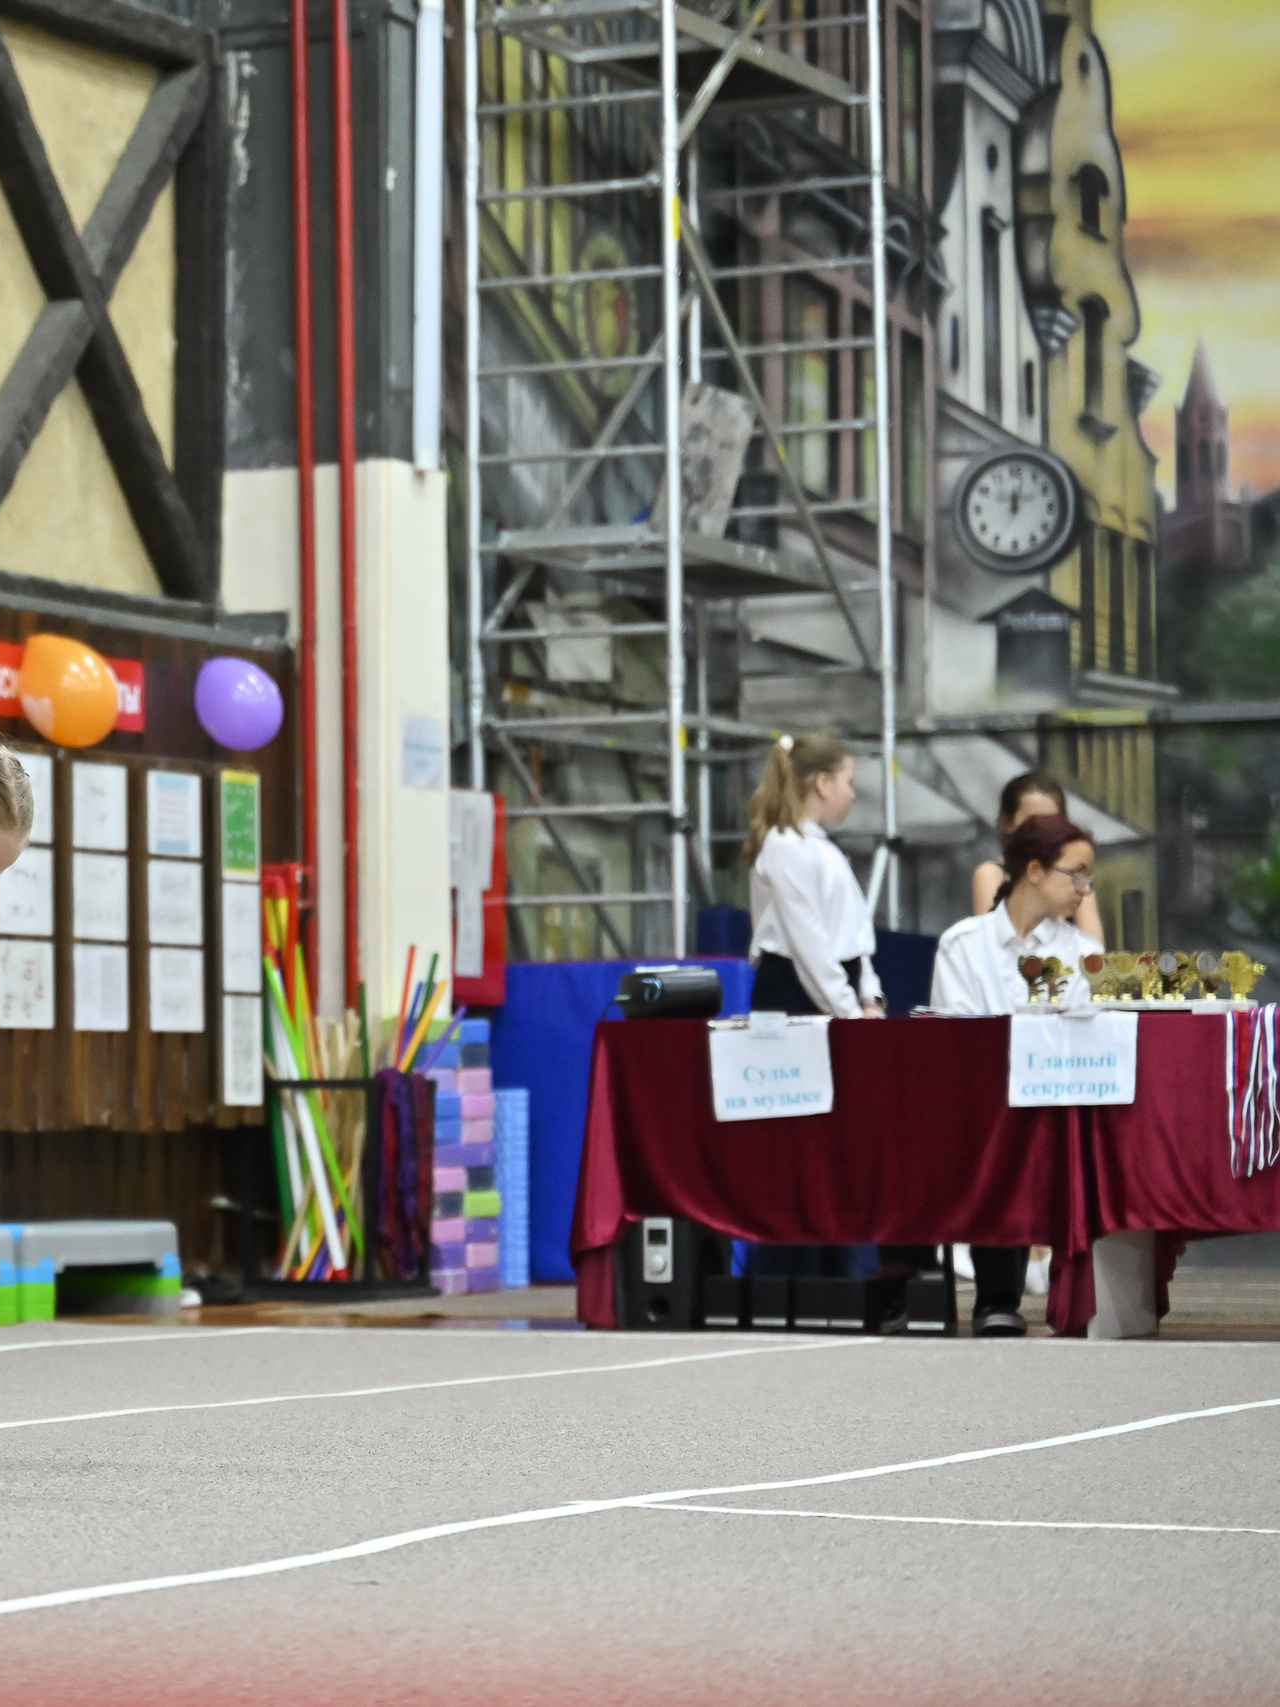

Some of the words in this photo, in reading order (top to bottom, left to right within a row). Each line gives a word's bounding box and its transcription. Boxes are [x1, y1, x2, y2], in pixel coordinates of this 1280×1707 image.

[1026, 1052, 1118, 1069] Главный
[742, 1065, 801, 1085] Судья
[1021, 1082, 1121, 1098] секретарь
[725, 1096, 747, 1110] на
[754, 1091, 822, 1111] музыке
